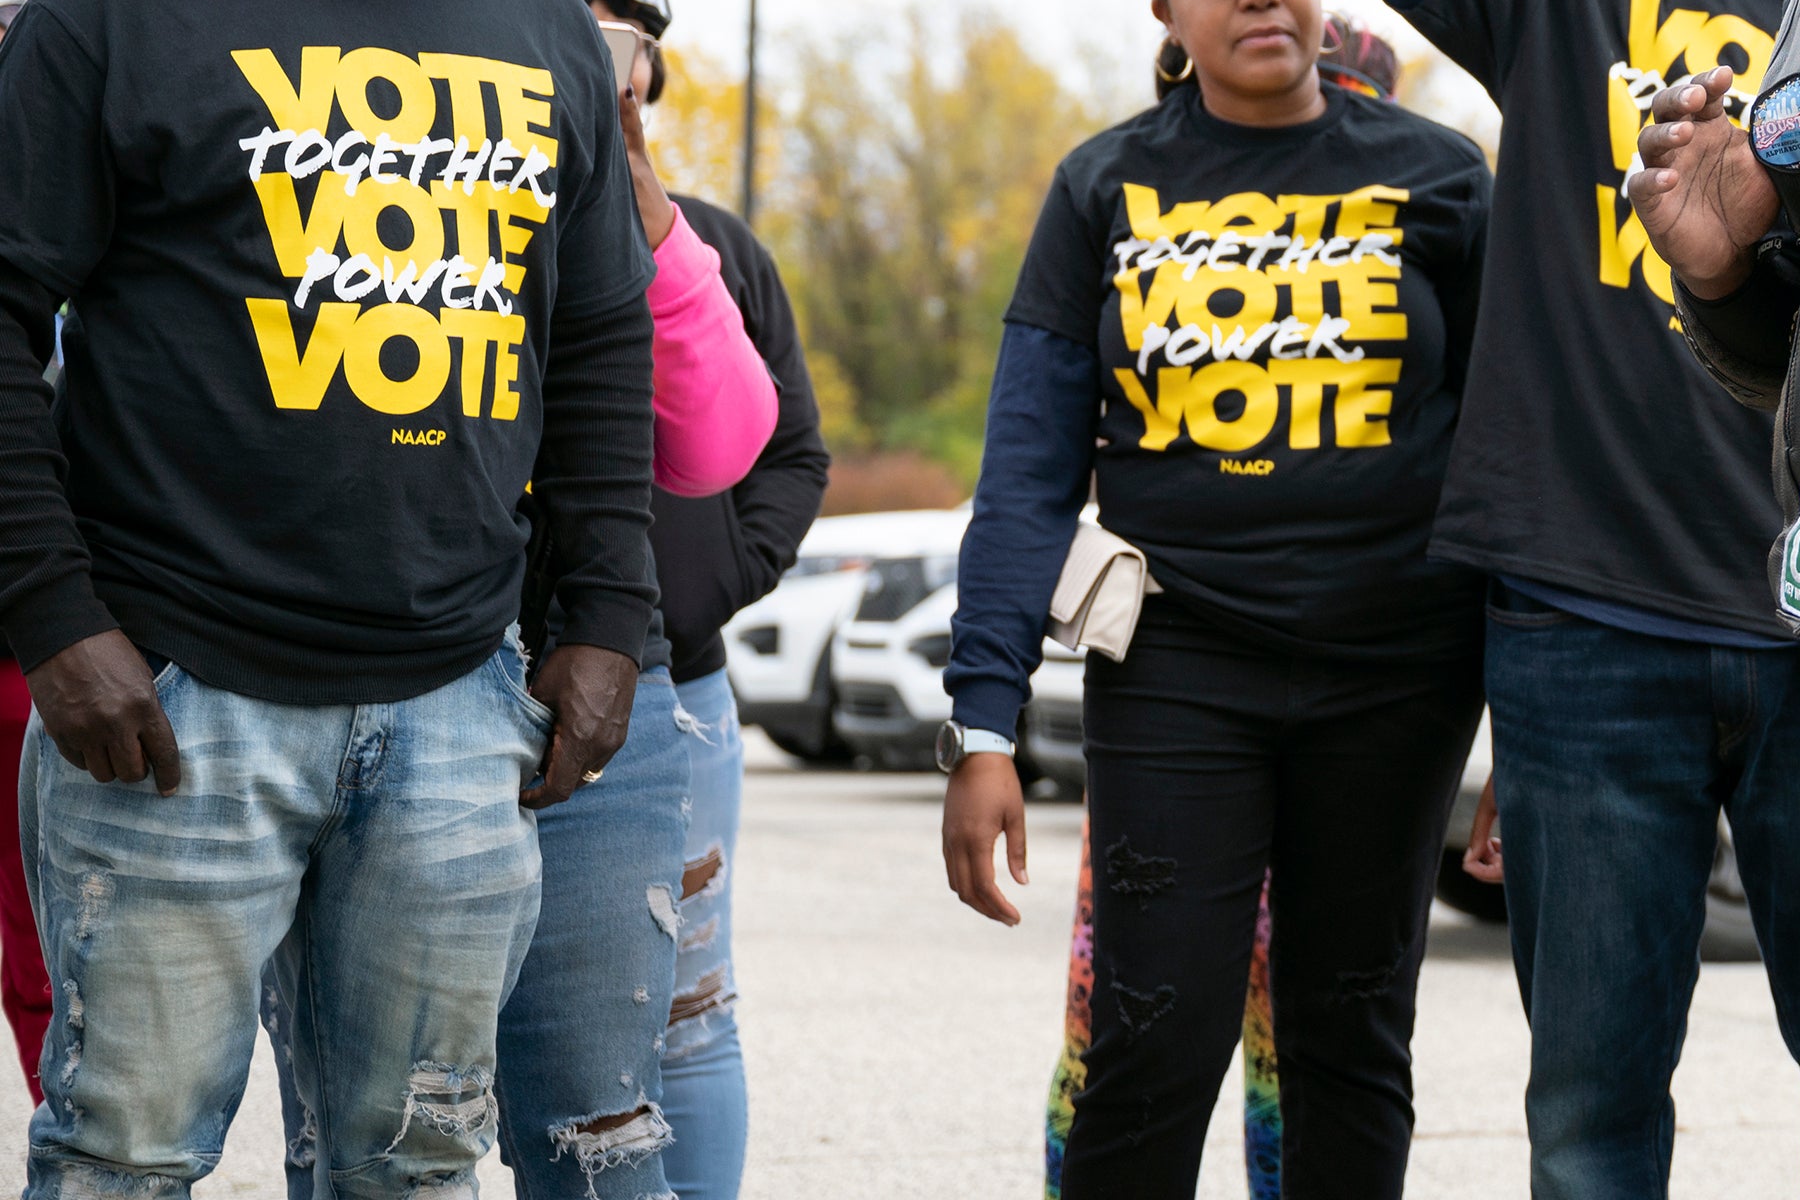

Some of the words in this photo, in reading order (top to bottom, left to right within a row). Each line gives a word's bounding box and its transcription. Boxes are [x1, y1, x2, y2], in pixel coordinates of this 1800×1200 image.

[229, 45, 558, 167] VOTE
[239, 126, 557, 209] TOGETHER
[253, 172, 552, 295] VOTE
[1122, 182, 1411, 246] VOTE
[294, 246, 513, 316] POWER
[1113, 230, 1402, 282] TOGETHER
[1113, 256, 1408, 352] VOTE
[245, 298, 526, 421] VOTE
[1137, 313, 1365, 376] POWER
[391, 428, 447, 447] NAACP
[1113, 358, 1403, 452] VOTE
[1219, 458, 1275, 476] NAACP
